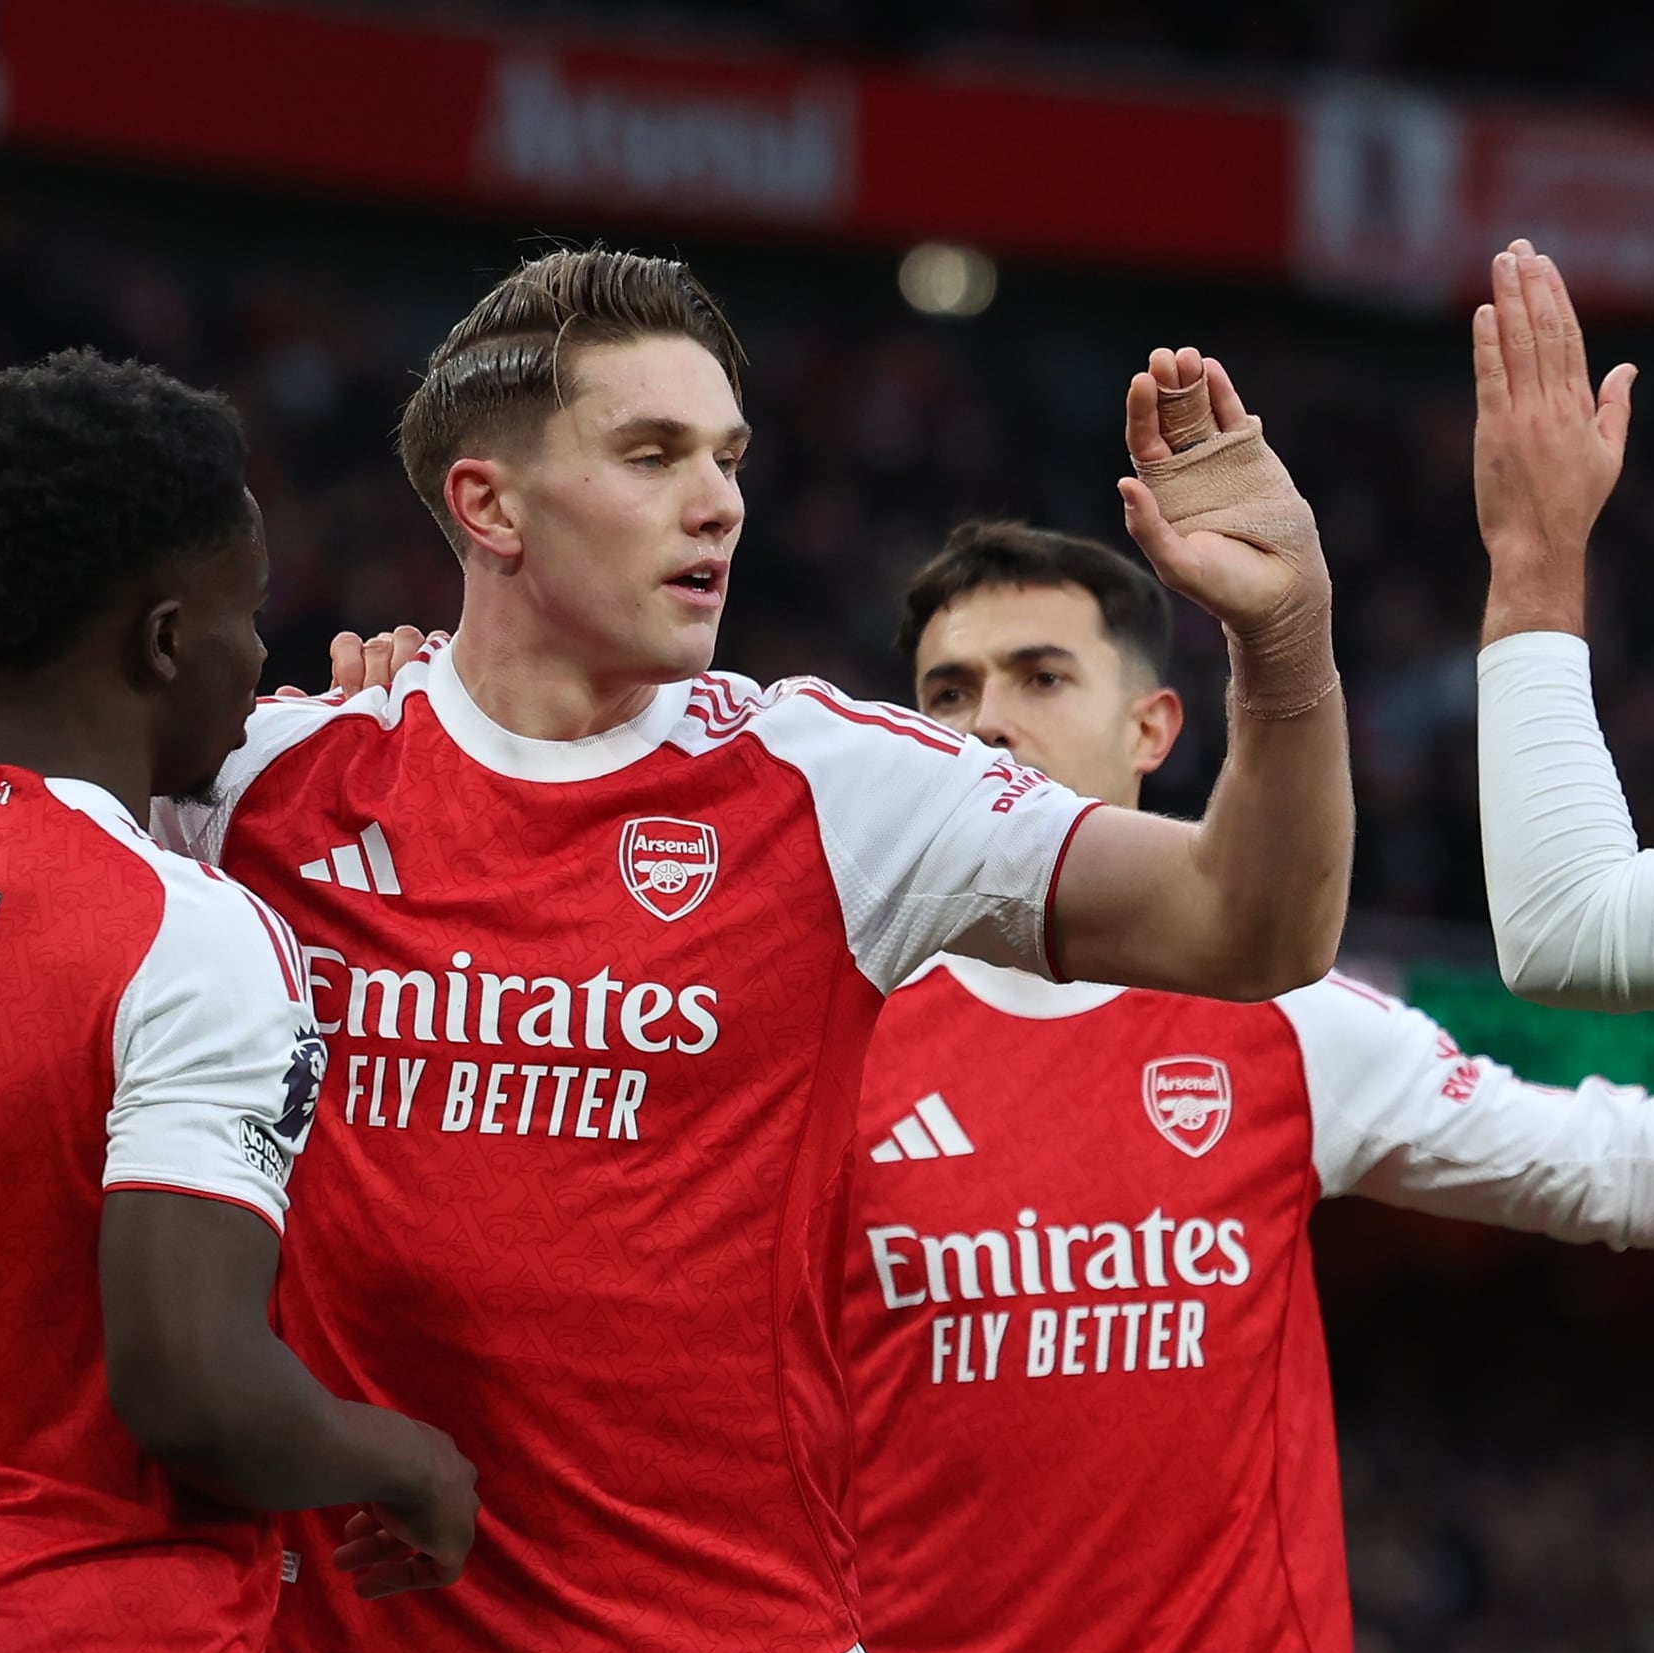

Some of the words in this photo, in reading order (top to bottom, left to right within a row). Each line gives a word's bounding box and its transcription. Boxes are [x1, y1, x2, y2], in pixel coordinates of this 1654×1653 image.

[634, 834, 705, 855] Arsenal
[304, 945, 720, 1055] Emirates
[345, 1055, 427, 1130] FLY
[442, 1061, 648, 1141] BETTER
[1156, 1076, 1218, 1092] Arsenal
[240, 1120, 264, 1151] No
[866, 1206, 1250, 1310] Emirates
[932, 1312, 1010, 1385] FLY
[1027, 1299, 1205, 1378] BETTER
